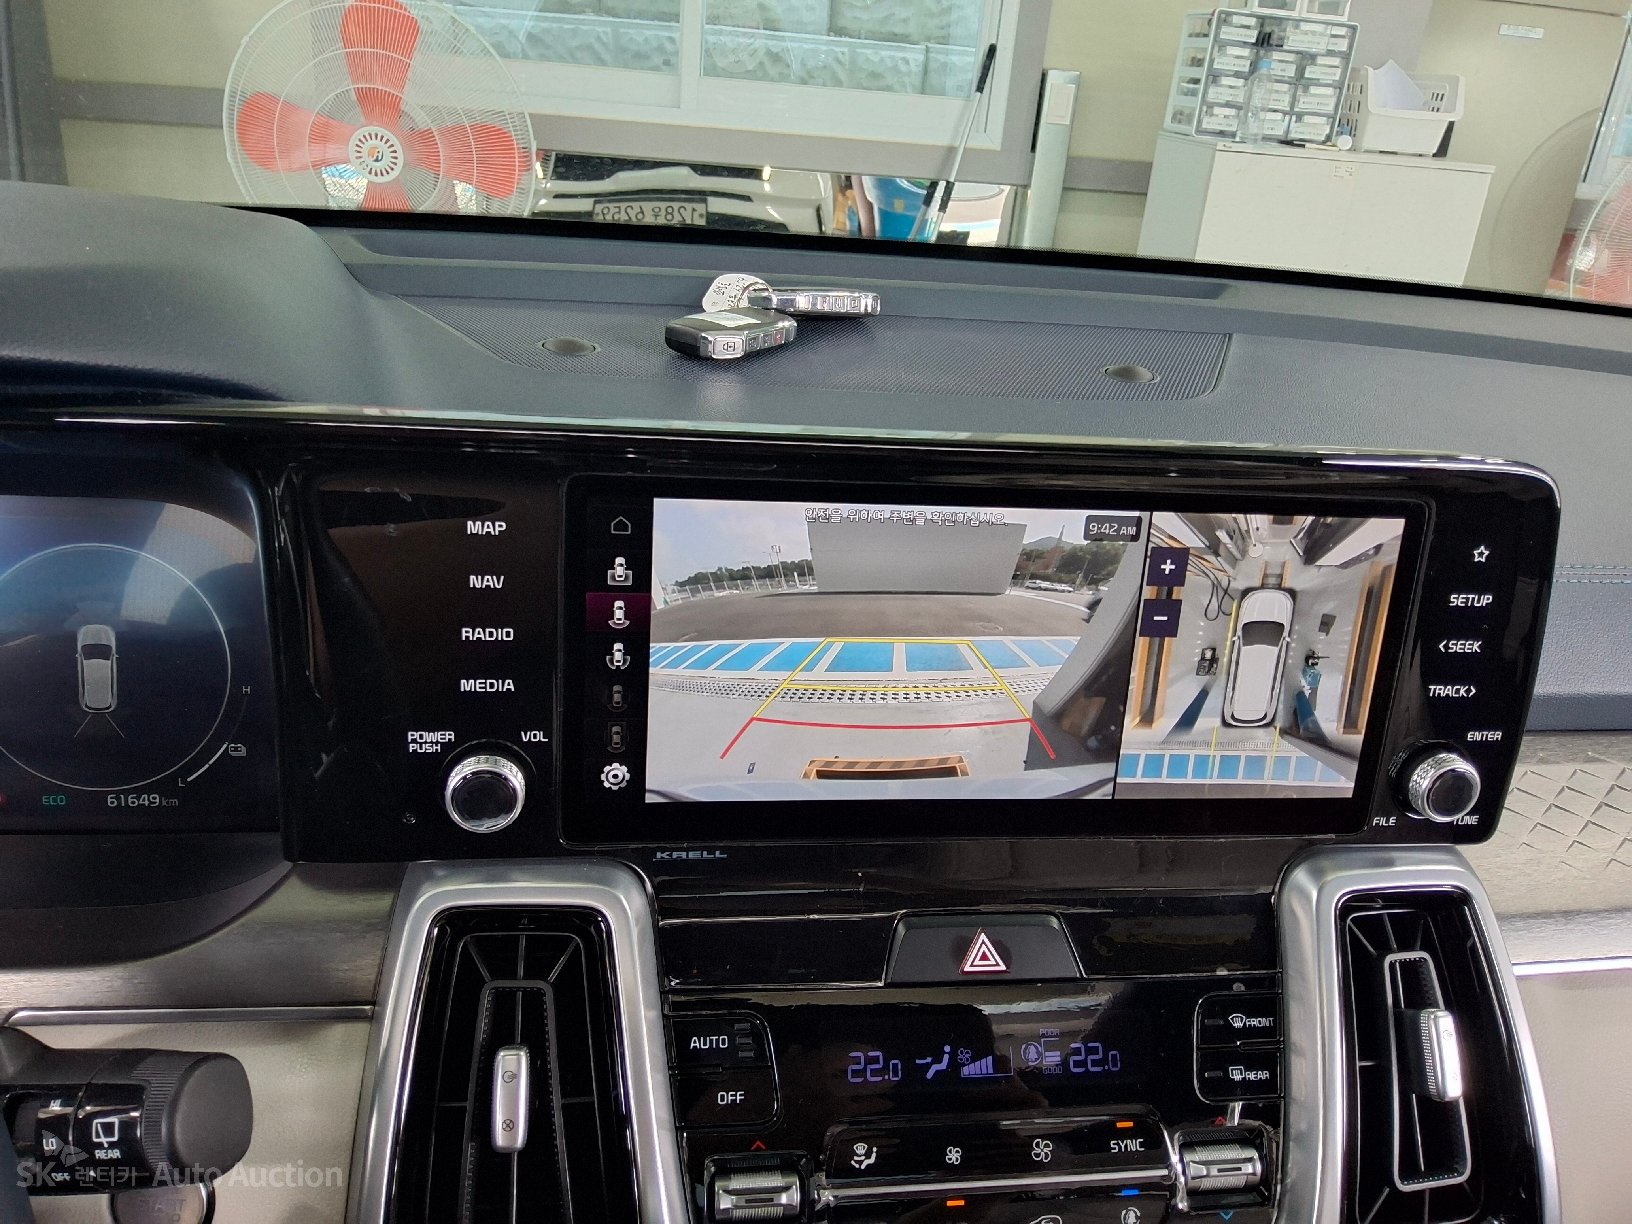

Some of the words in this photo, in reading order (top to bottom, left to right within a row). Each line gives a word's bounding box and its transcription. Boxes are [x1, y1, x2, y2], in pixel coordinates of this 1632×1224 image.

[804, 508, 843, 523] 안전을
[846, 509, 885, 523] 위하여
[889, 510, 927, 526] 주변을
[930, 511, 1009, 527] 확인하십시오.
[466, 520, 507, 536] MAP
[1089, 523, 1119, 535] 9:42
[1120, 526, 1137, 536] AM
[469, 575, 505, 589] NAV
[1449, 594, 1493, 607] SETUP
[461, 627, 515, 641] RADIO
[242, 685, 251, 695] H
[460, 679, 515, 692] MEDIA
[407, 731, 455, 743] POWER
[521, 731, 548, 742] VOL
[1467, 731, 1502, 742] ENTER
[408, 743, 441, 753] PUSH
[178, 778, 185, 787] L
[42, 795, 66, 806] ECO
[107, 794, 160, 808] 61649
[161, 797, 179, 807] km
[1372, 816, 1397, 827] FILE
[656, 850, 728, 859] KRELL
[1245, 1017, 1275, 1028] FRONT
[689, 1035, 728, 1050] AUTO
[1069, 1042, 1121, 1073] 22.0
[848, 1051, 902, 1083] 22.0
[1245, 1070, 1270, 1081] REAR
[717, 1091, 745, 1105] OFF
[42, 1138, 57, 1151] LO
[1110, 1138, 1145, 1153] SYNC
[94, 1149, 121, 1160] REAR
[51, 1172, 71, 1182] OFF
